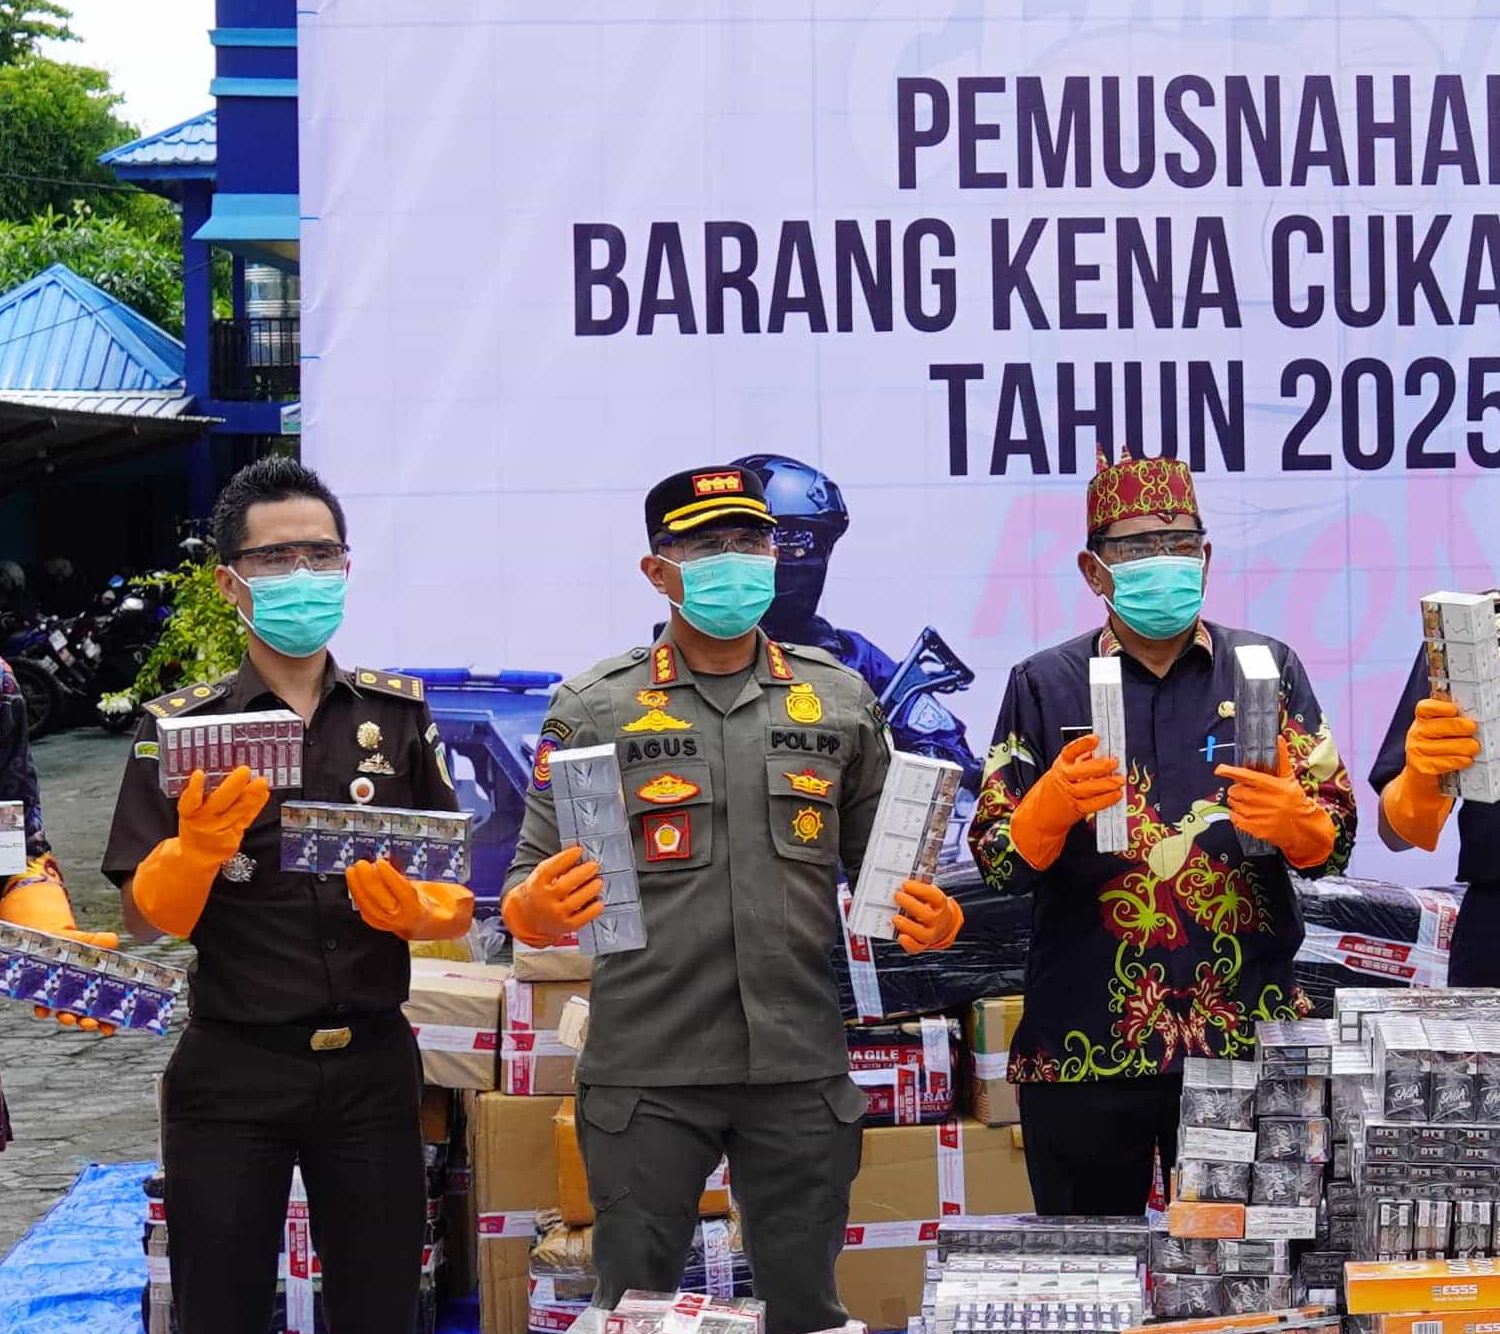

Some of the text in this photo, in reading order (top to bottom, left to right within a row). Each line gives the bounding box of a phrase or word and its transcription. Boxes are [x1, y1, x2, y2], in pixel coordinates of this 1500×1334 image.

[574, 218, 956, 336] BARANG
[992, 217, 1242, 330] KENA
[930, 360, 1246, 476] TAHUN
[627, 737, 698, 763] AGUS
[771, 730, 841, 757] POL PP
